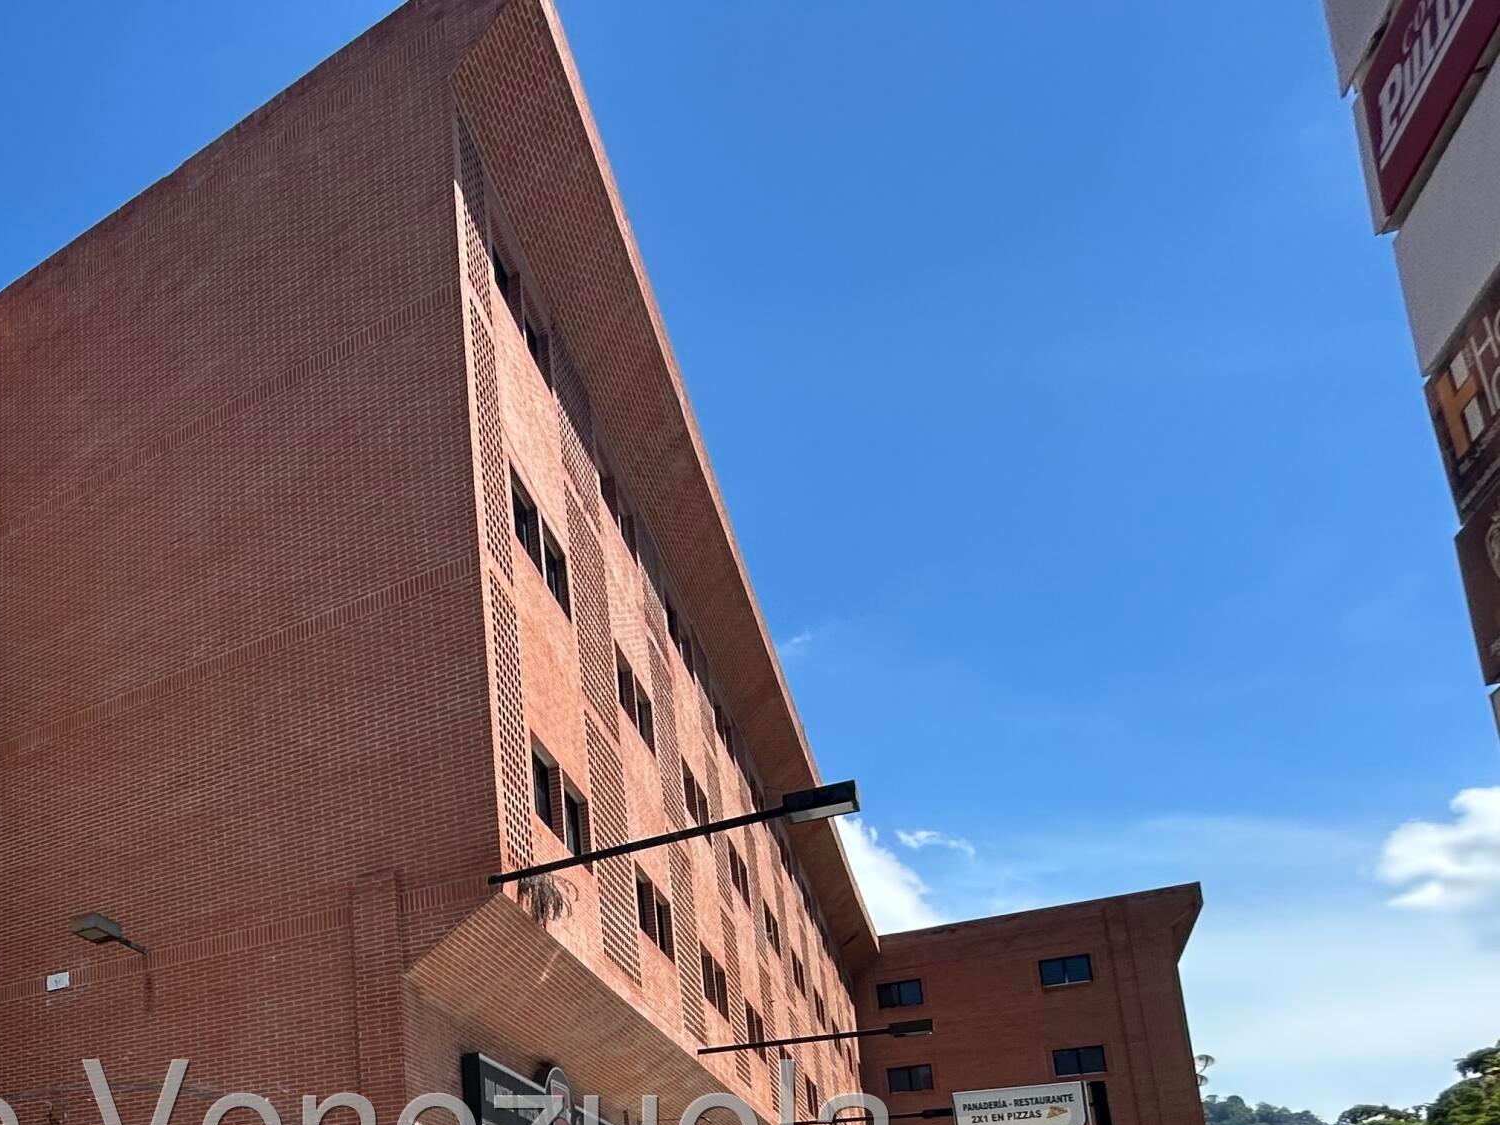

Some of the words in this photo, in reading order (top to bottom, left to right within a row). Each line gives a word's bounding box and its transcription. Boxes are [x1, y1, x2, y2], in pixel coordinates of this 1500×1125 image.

[1013, 1093, 1075, 1108] RESTAURANTE
[971, 1114, 989, 1124] 2X1
[991, 1112, 1005, 1122] EN
[1007, 1109, 1042, 1120] PIZZAS
